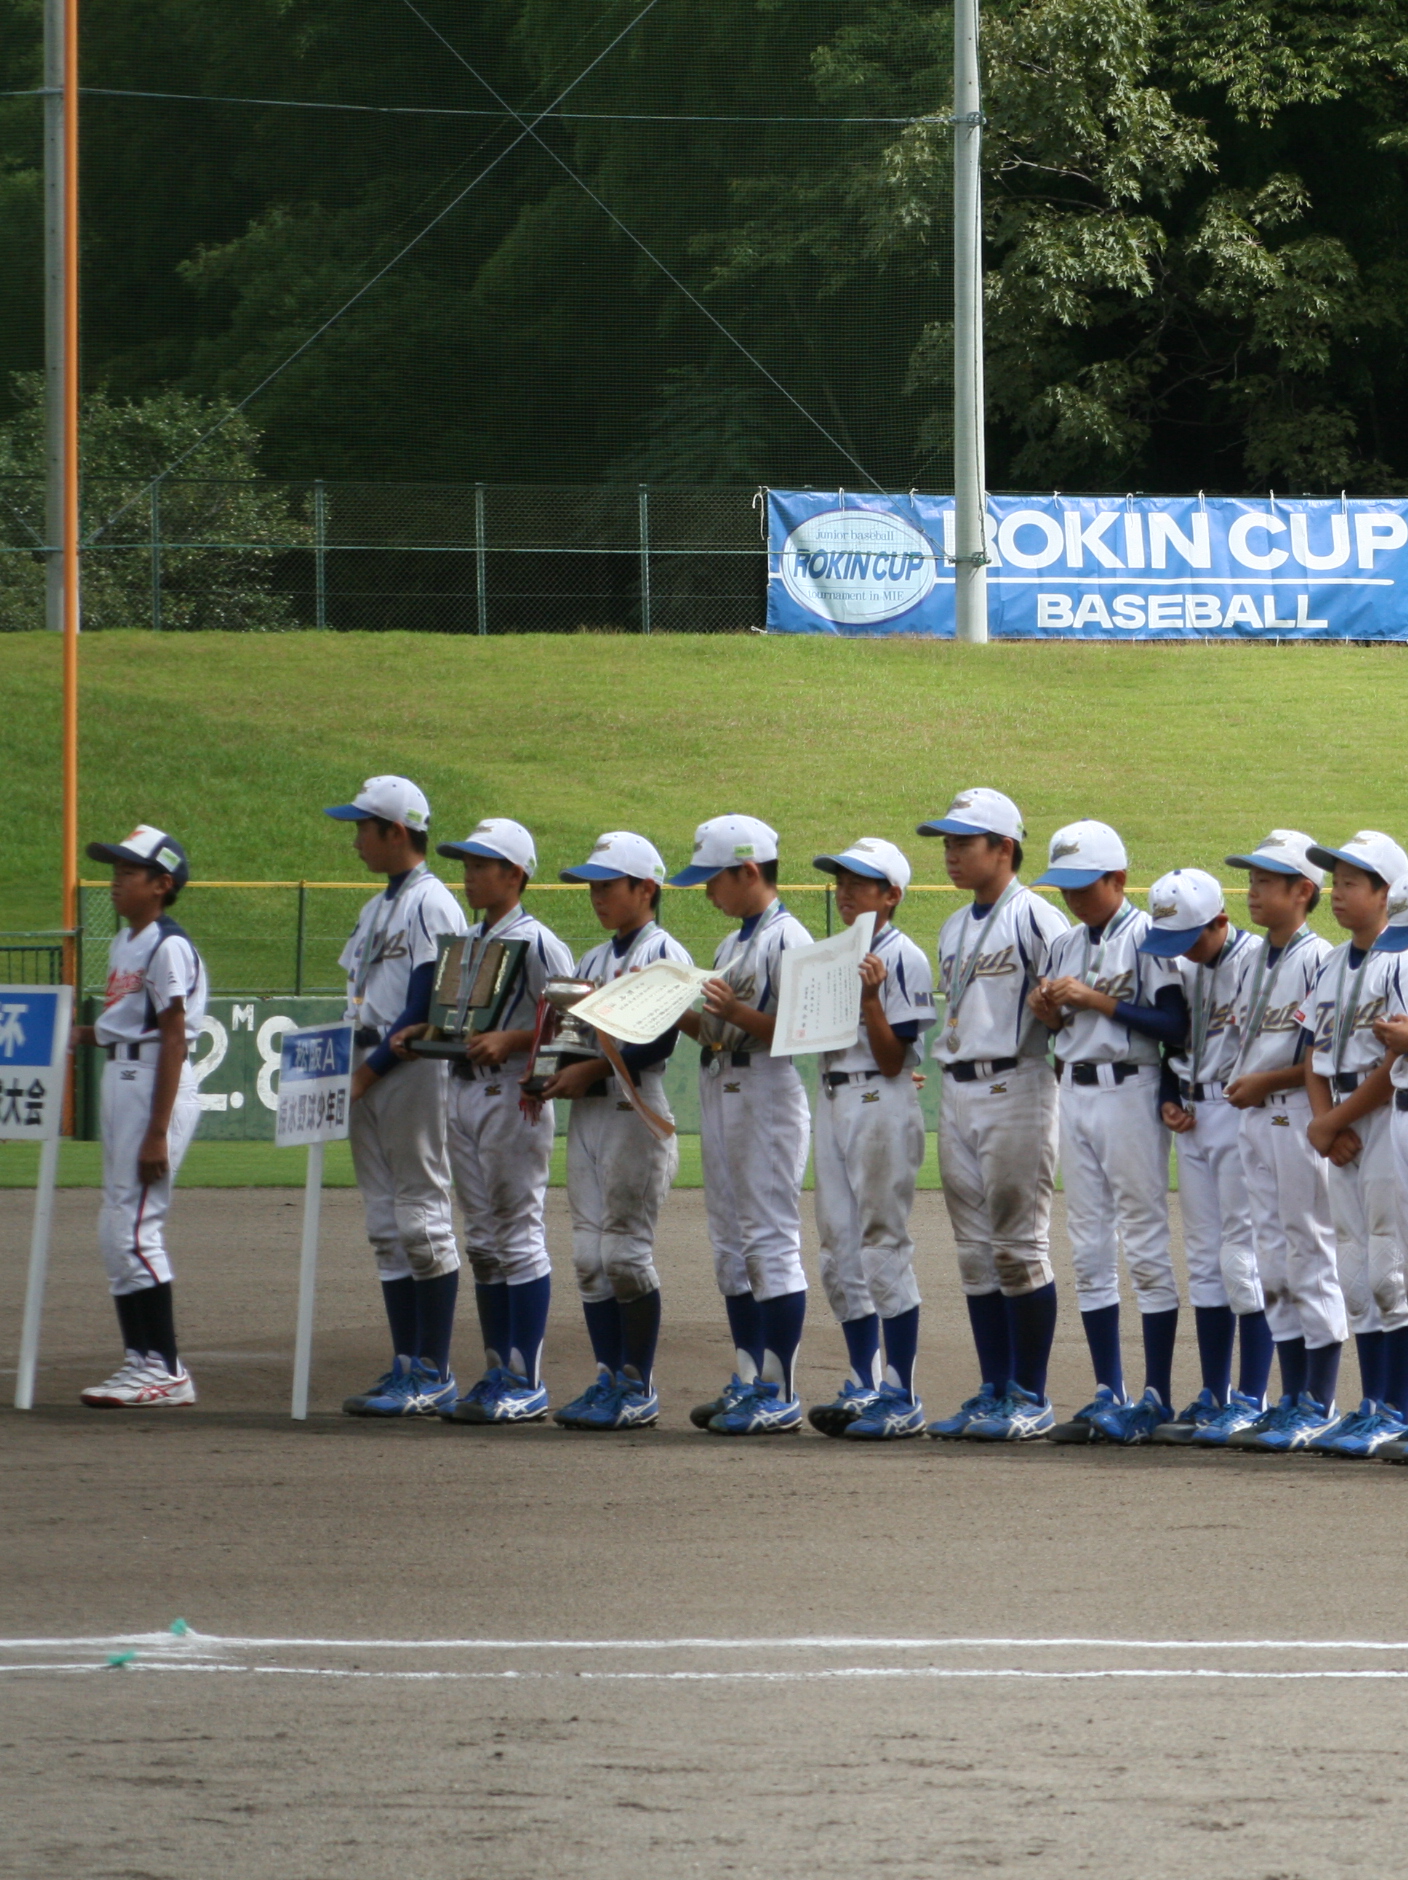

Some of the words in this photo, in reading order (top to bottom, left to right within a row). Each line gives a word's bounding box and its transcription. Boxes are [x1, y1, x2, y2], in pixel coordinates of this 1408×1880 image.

[815, 528, 848, 541] junior
[850, 530, 894, 541] baseball
[943, 509, 1205, 570] ROKIN
[1228, 511, 1408, 571] CUP
[793, 548, 871, 581] ROKIN
[872, 551, 924, 582] CUP
[808, 589, 867, 601] tournament
[869, 590, 879, 601] in
[882, 590, 904, 601] MIE
[1037, 593, 1328, 629] BASEBALL
[232, 1004, 254, 1031] M
[0, 1077, 46, 1126] 大会
